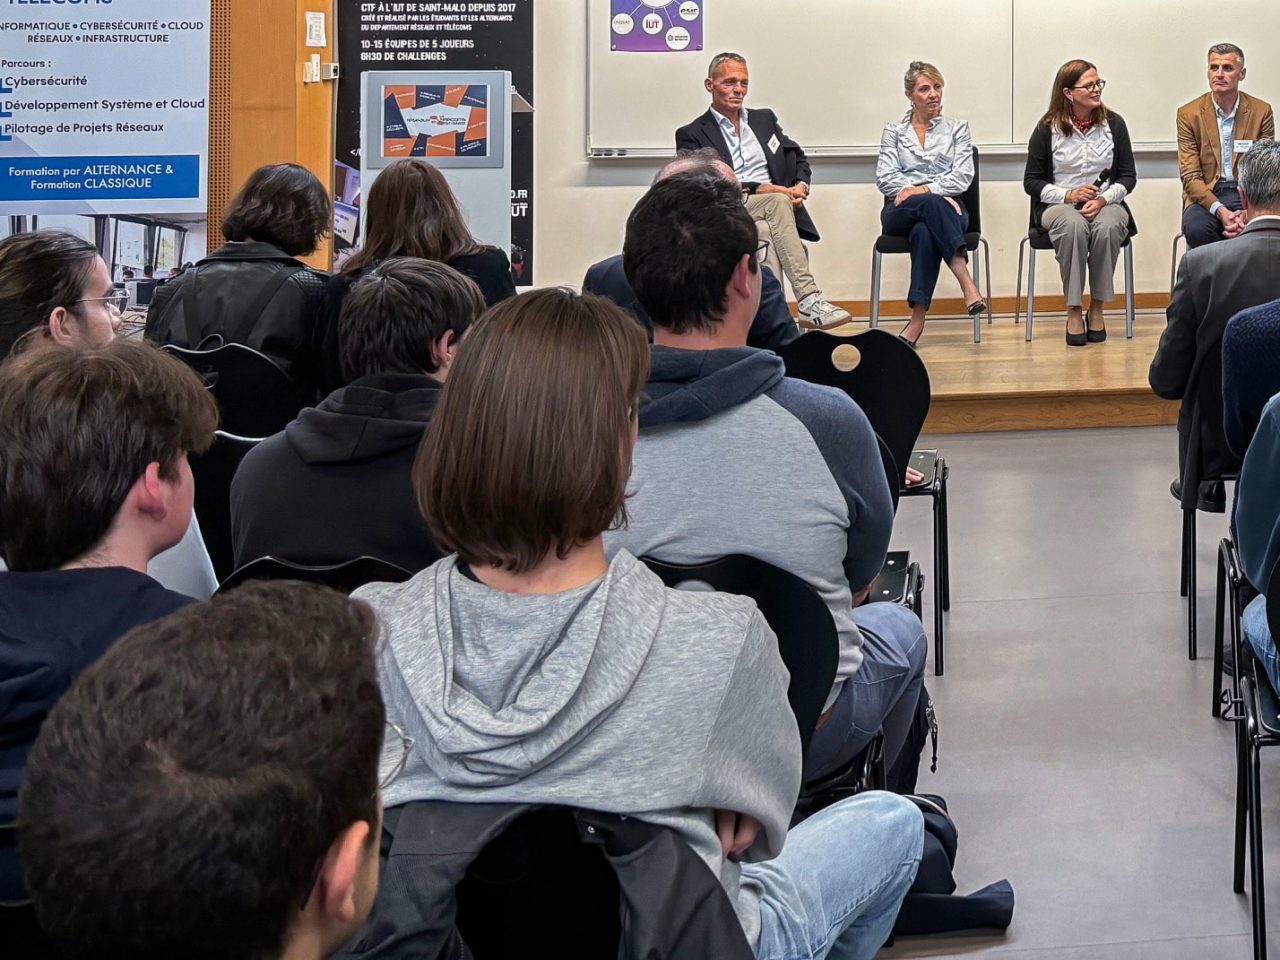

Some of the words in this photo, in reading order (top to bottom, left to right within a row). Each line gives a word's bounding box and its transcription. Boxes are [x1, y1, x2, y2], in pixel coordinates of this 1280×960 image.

[361, 3, 376, 12] CTF
[378, 1, 385, 12] À
[406, 3, 417, 12] DE
[419, 3, 466, 12] SAINT-MALO
[468, 3, 496, 12] DEPUIS
[497, 3, 516, 12] 2017
[0, 22, 70, 30] NFORMATIQUE
[80, 21, 158, 30] CYBERSÉCURITÉ
[168, 21, 204, 30] CLOUD
[410, 22, 434, 31] RÉSEAUX
[28, 33, 73, 43] RÉSEAUX
[83, 34, 169, 43] INFRASTRUCTURE
[361, 40, 383, 49] 10-15
[385, 38, 417, 49] ÉQUIPES
[419, 40, 429, 49] DE
[432, 40, 437, 49] 5
[439, 40, 474, 49] JOUEURS
[360, 52, 382, 60] 6H30
[384, 52, 395, 60] DE
[397, 52, 447, 60] CHALLENGES
[1, 60, 45, 68] Parcours
[5, 75, 88, 88] Cybersécurité
[5, 100, 99, 112] Développement
[101, 99, 153, 112] Système
[155, 99, 168, 108] et
[170, 99, 205, 109] Cloud
[4, 123, 53, 135] Pilotage
[56, 123, 70, 133] de
[73, 123, 113, 135] Projets
[116, 123, 164, 133] Réseaux
[9, 167, 60, 176] Formation
[63, 168, 81, 177] par
[84, 165, 162, 175] ALTERNANCE
[165, 165, 173, 174] &
[31, 180, 81, 189] Formation
[84, 178, 152, 188] CLASSIQUE
[511, 205, 528, 216] UT
